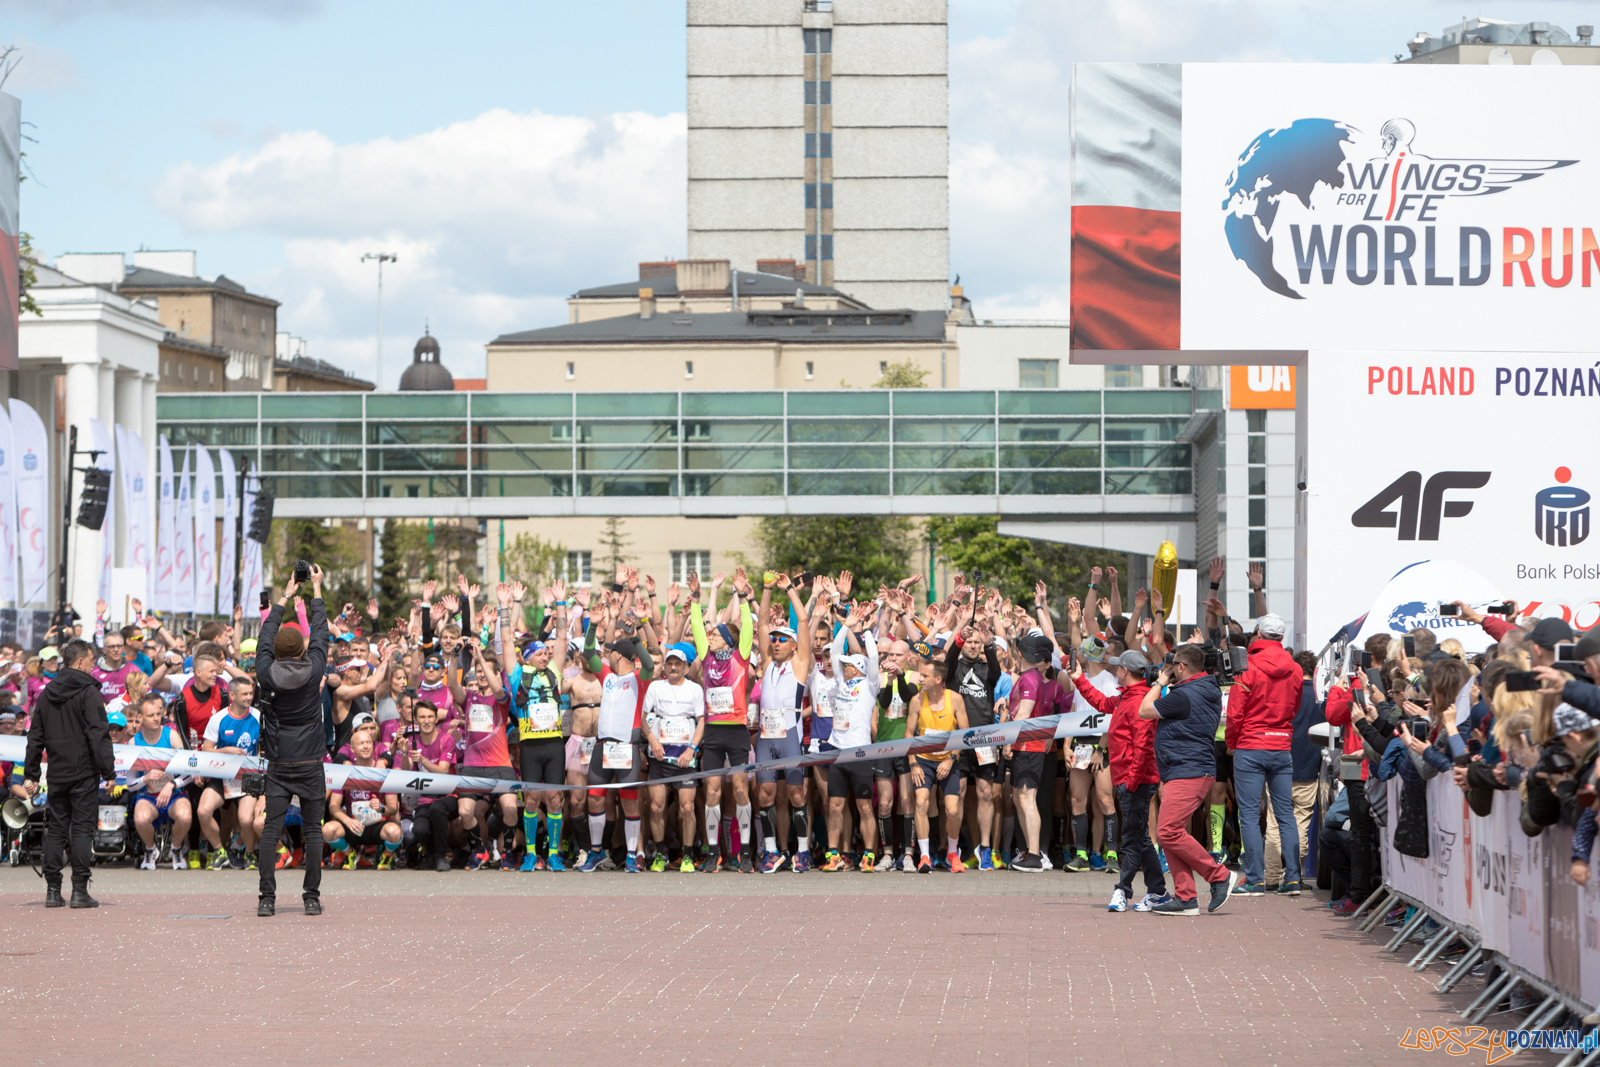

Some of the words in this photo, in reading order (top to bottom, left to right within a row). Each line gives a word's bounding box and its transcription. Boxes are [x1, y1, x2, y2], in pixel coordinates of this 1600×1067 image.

[1346, 152, 1483, 191] WINGS
[1336, 193, 1367, 205] FOR
[1362, 193, 1445, 222] LIFE
[1289, 224, 1491, 286] WORLD
[1367, 366, 1475, 396] POLAND
[1494, 360, 1600, 397] POZNAŃ
[1351, 470, 1492, 541] 4F
[1516, 563, 1557, 580] Bank
[1079, 713, 1106, 729] 4F
[970, 736, 993, 746] WORLD
[993, 735, 1006, 743] RUN
[405, 777, 434, 791] 4F
